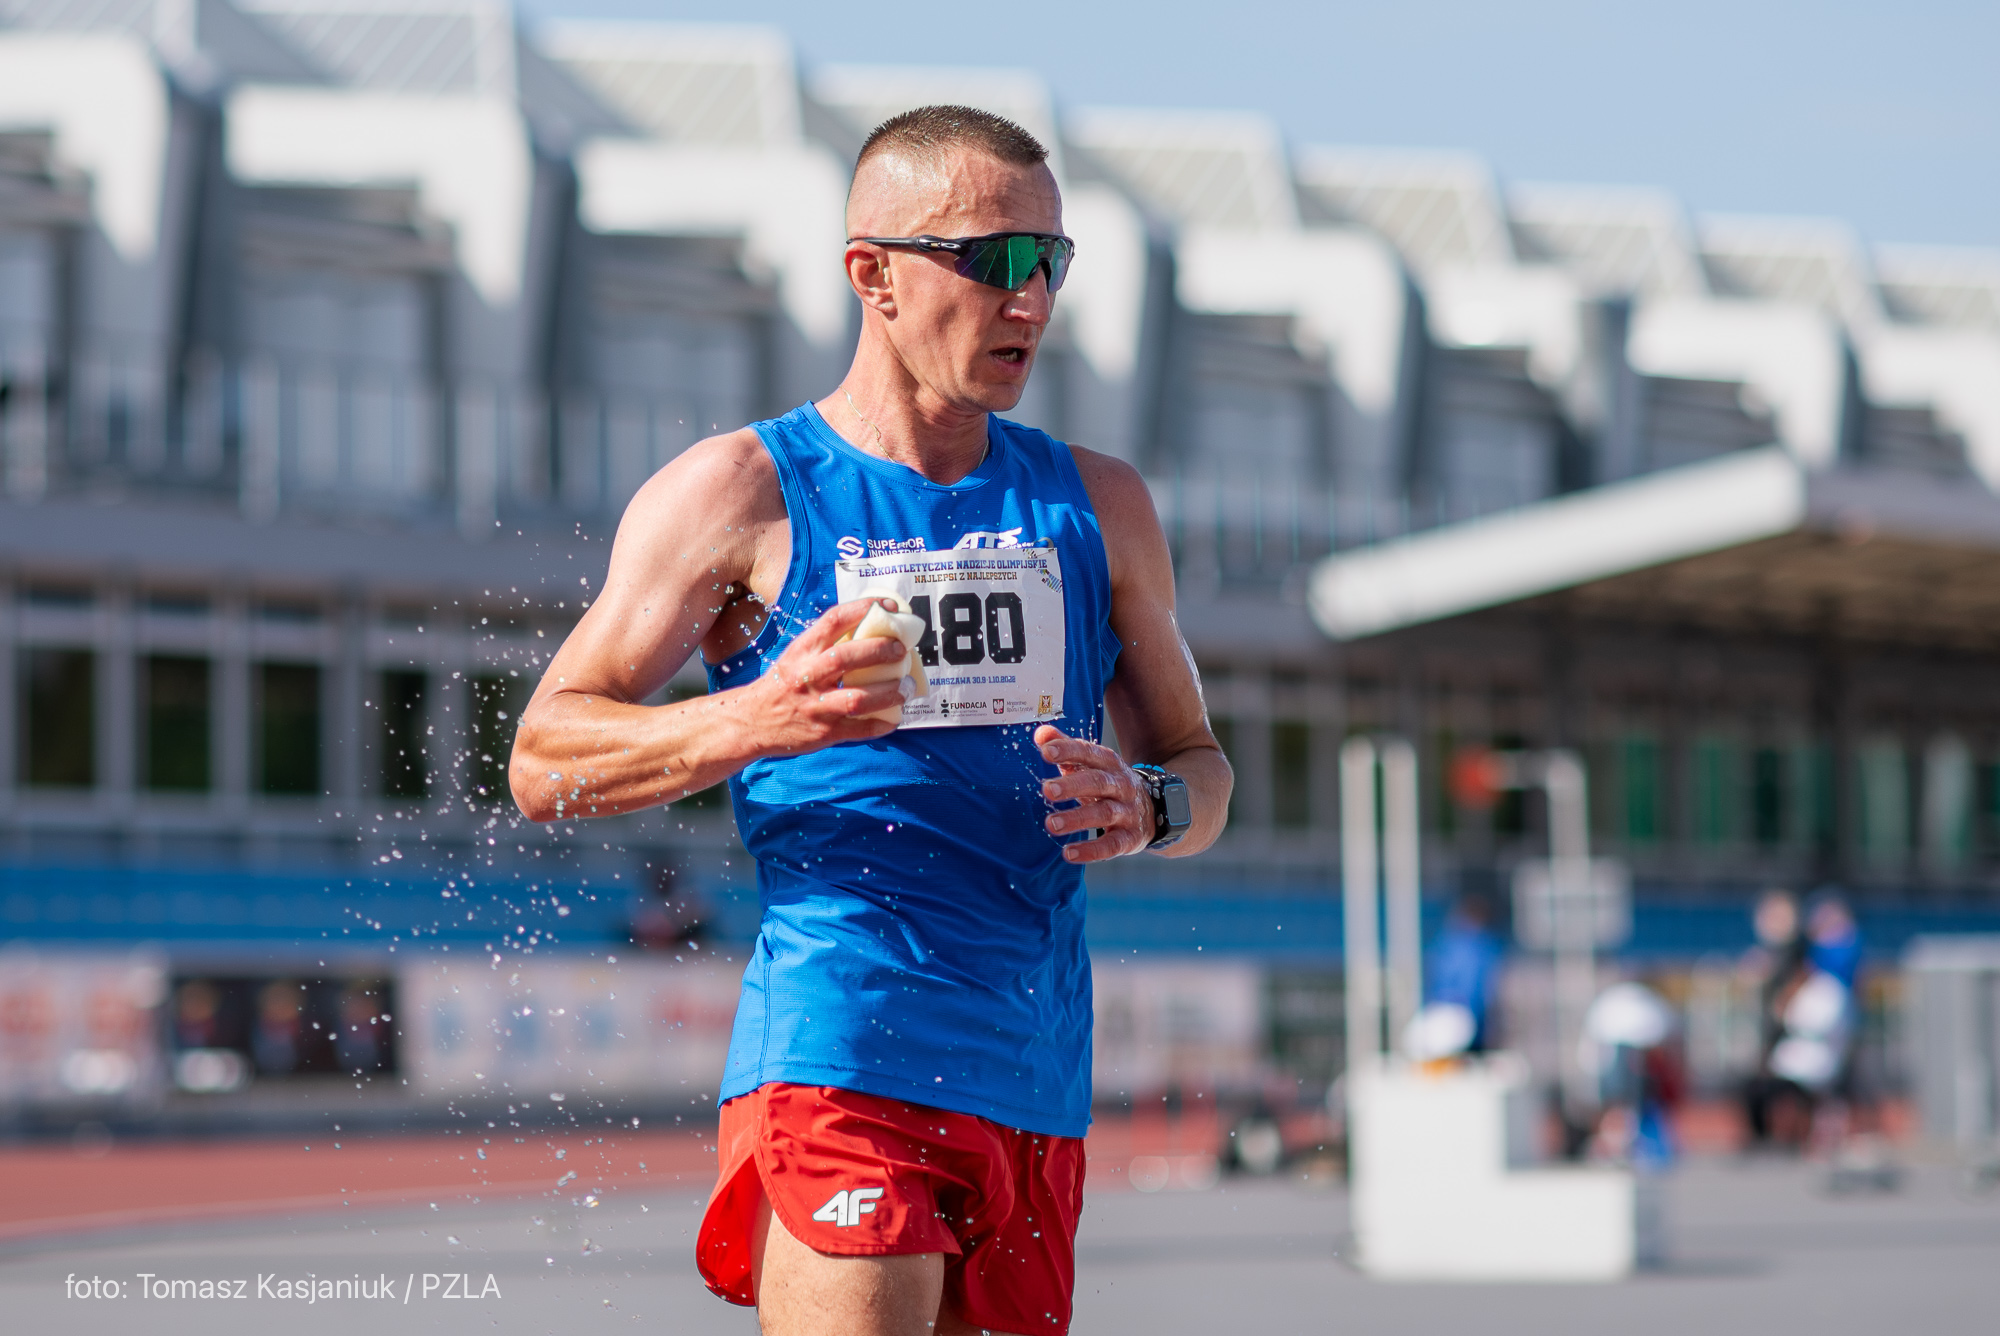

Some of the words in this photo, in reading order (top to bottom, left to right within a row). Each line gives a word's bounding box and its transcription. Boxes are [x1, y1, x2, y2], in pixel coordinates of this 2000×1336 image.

[953, 527, 1022, 549] ATS
[956, 560, 996, 570] NADZIEJE
[996, 559, 1048, 570] OLIMPIJSKIE
[914, 572, 958, 583] NAJLEPSI
[959, 573, 966, 581] Z
[967, 571, 1018, 581] NAJLEPSZYCH
[929, 677, 971, 686] WARSZAWA
[950, 701, 987, 710] FUNDACJA
[812, 1187, 884, 1227] 4F
